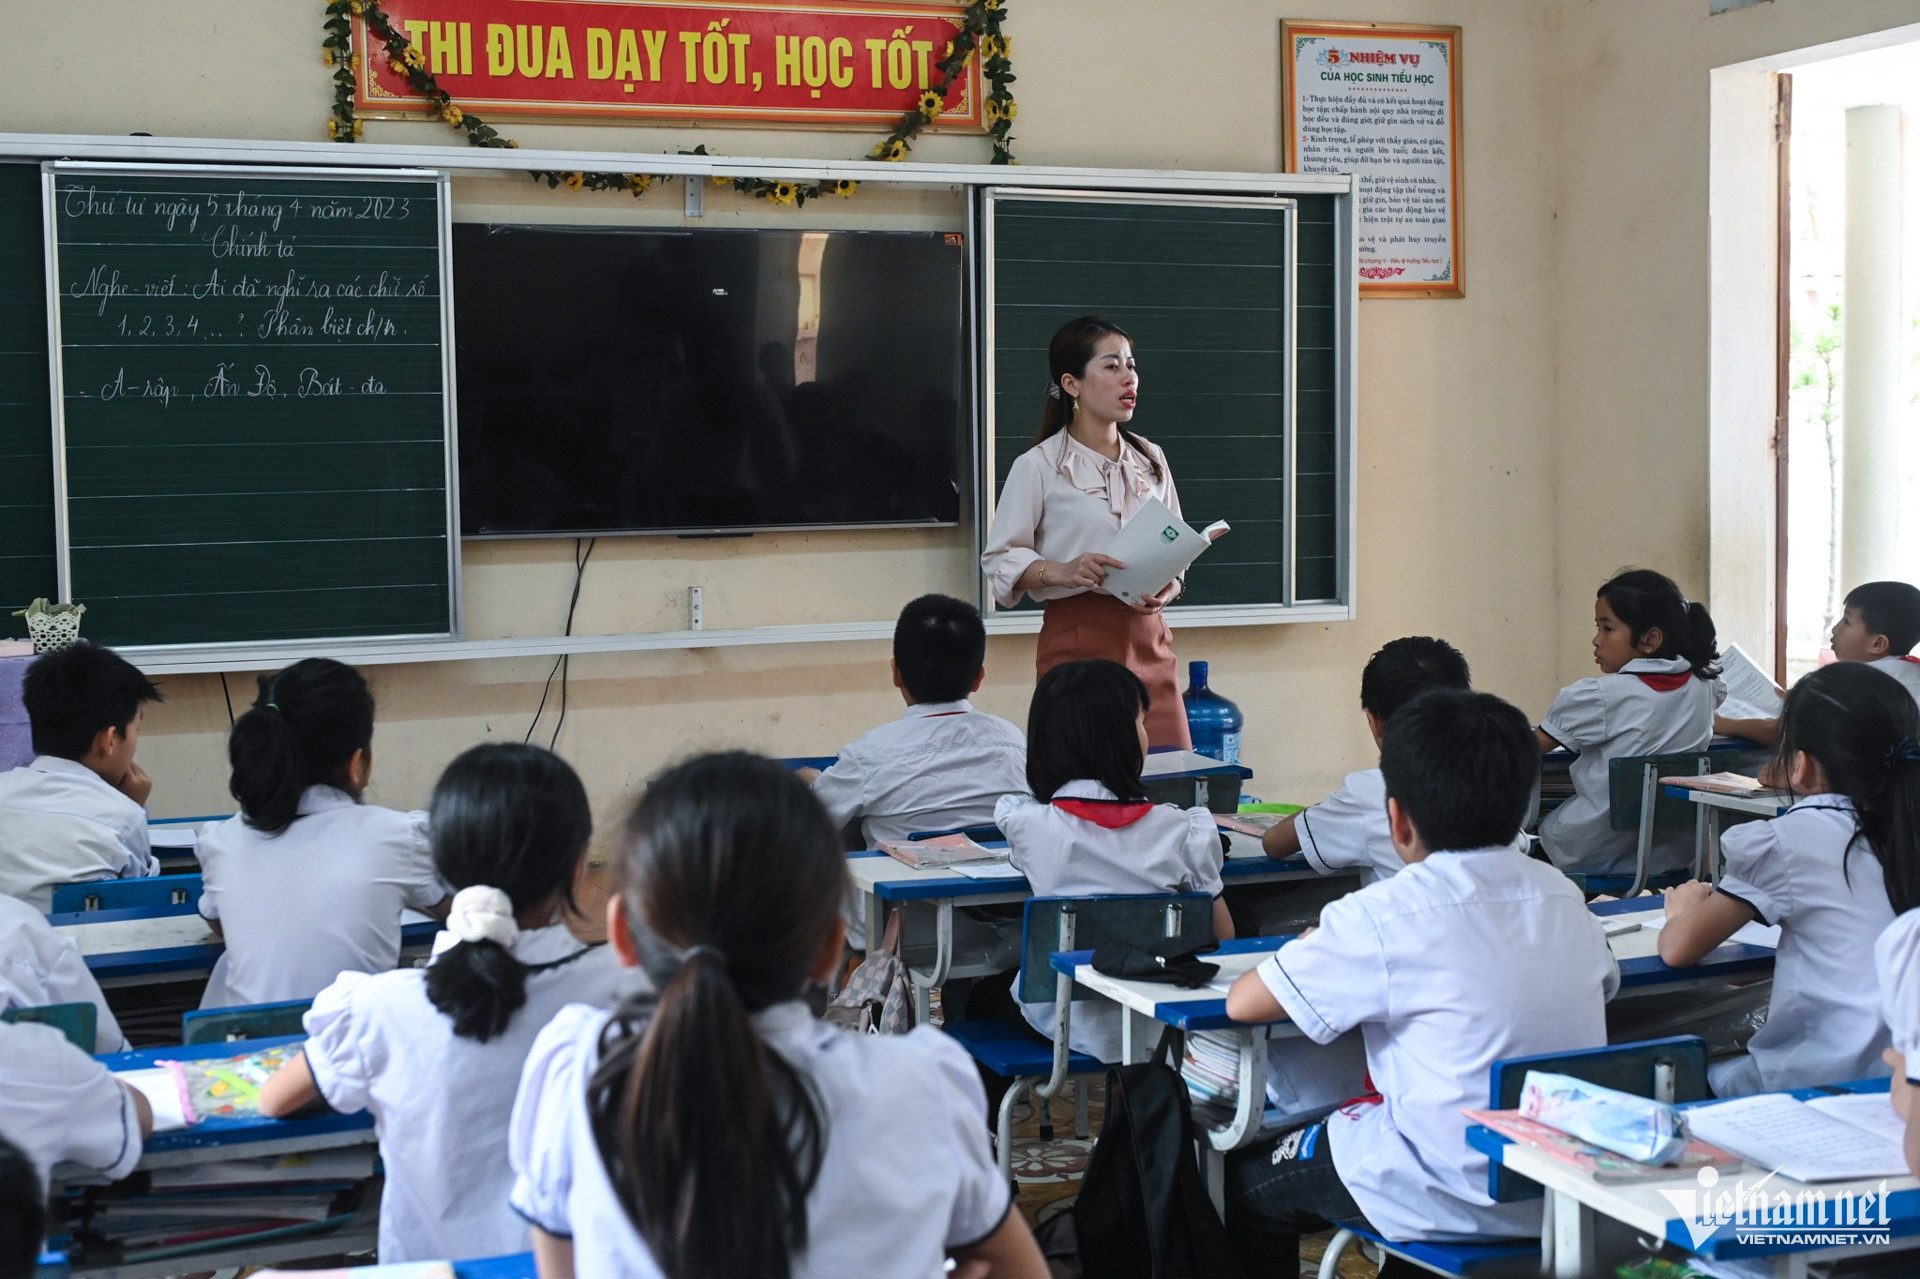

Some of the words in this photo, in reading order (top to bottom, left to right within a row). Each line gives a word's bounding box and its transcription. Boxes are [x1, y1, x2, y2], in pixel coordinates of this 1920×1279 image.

[404, 20, 473, 76] THI
[486, 23, 575, 79] ĐUA
[587, 27, 668, 93] DẠY
[679, 18, 763, 92] TỐT,
[776, 35, 854, 98] HỌC
[865, 26, 934, 90] TỐT
[1327, 49, 1341, 64] 5
[1349, 50, 1397, 67] NHIỆM
[1399, 53, 1420, 68] VỤ
[1320, 68, 1341, 81] CỦA
[1344, 72, 1364, 84] HỌC
[1366, 73, 1389, 82] SINH
[1391, 69, 1412, 83] TIỂU
[1414, 75, 1434, 86] HỌC
[65, 184, 121, 218] Thứ
[126, 196, 147, 216] tư
[154, 198, 200, 234] ngày
[207, 194, 219, 216] 5
[226, 190, 283, 232] tháng
[290, 198, 303, 218] 4
[311, 200, 353, 220] năm
[355, 196, 410, 220] 2023
[202, 225, 271, 258] Chính
[277, 235, 297, 258] tả
[193, 268, 227, 299] Ai
[232, 275, 262, 298] đã
[266, 269, 306, 313] nghĩ
[305, 281, 331, 299] ra
[337, 275, 363, 298] các
[368, 270, 400, 298] chữ
[405, 274, 430, 298] số
[258, 309, 314, 339] Phân
[320, 307, 352, 343] biệt
[203, 362, 240, 398] Ấn
